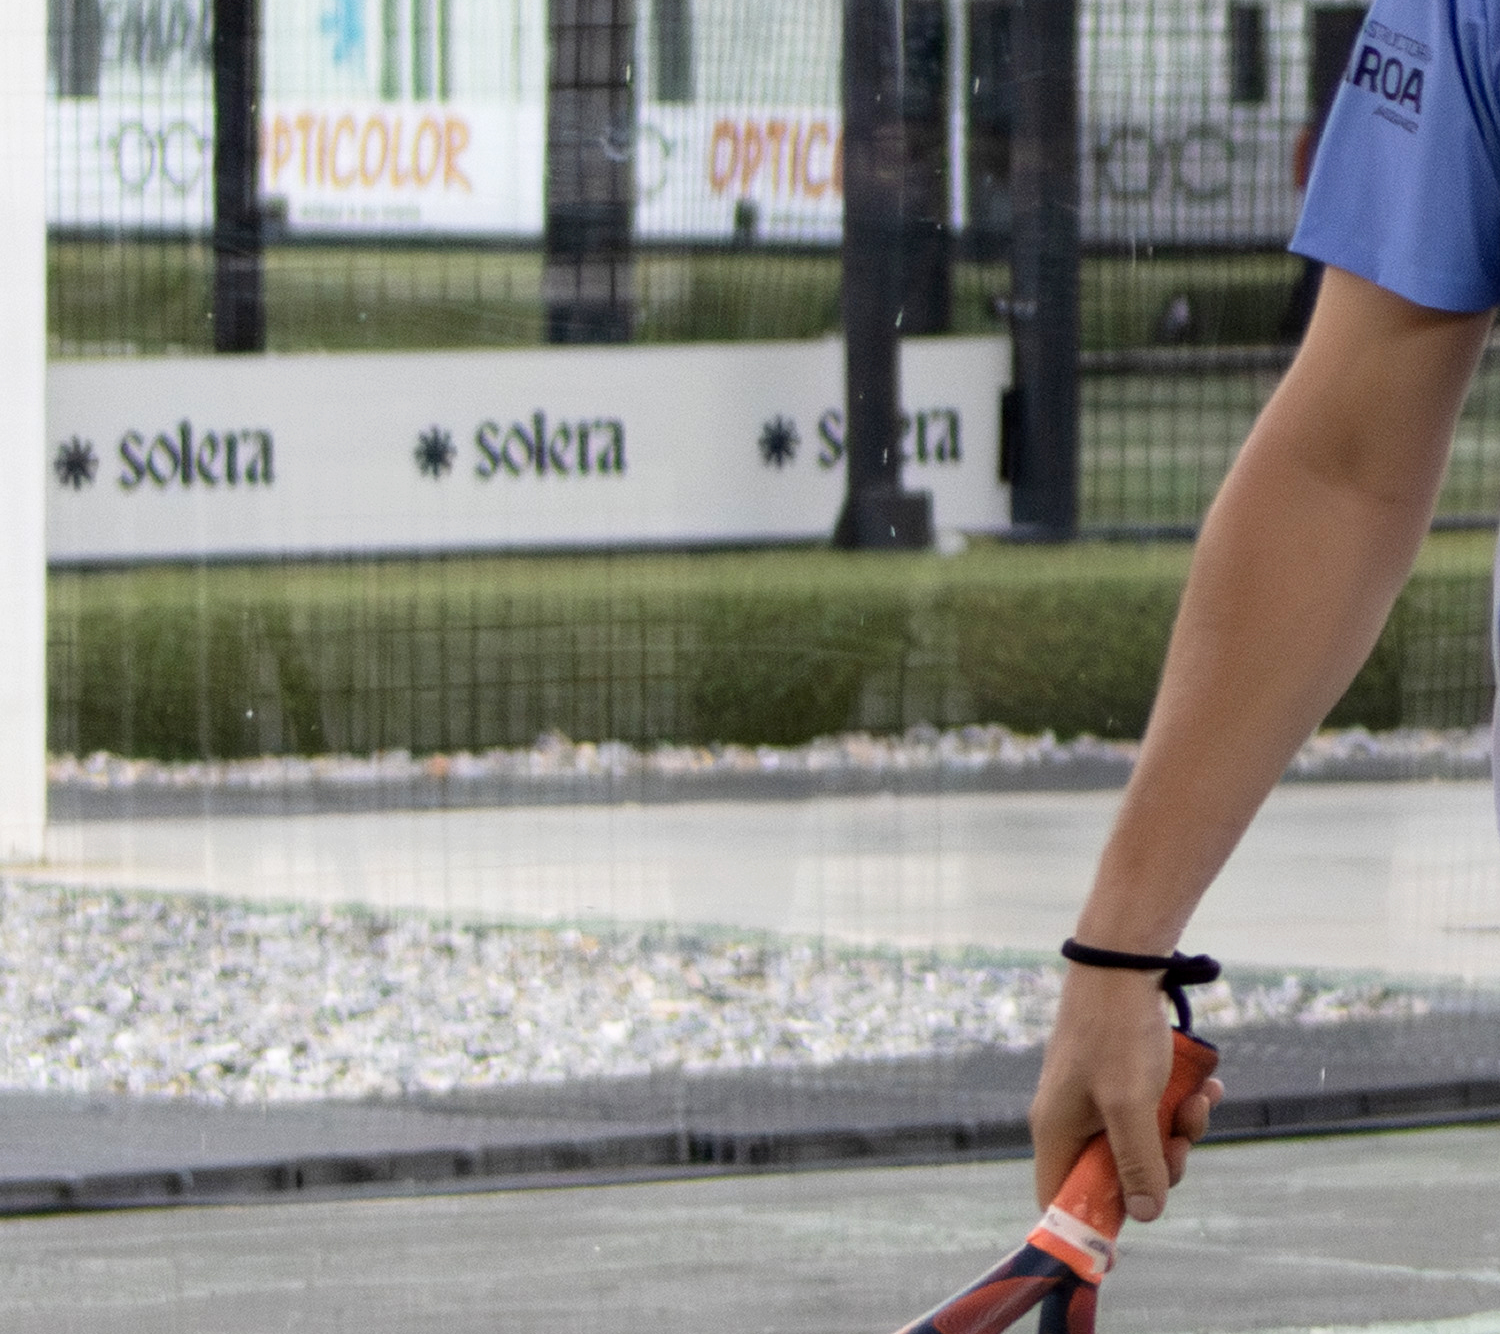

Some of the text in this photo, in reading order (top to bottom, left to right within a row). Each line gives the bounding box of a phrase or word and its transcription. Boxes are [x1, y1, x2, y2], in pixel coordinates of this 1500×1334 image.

[258, 111, 470, 194] PTICOLOR
[709, 122, 842, 200] OPTIC
[119, 421, 274, 490] solera
[475, 412, 626, 479] solera
